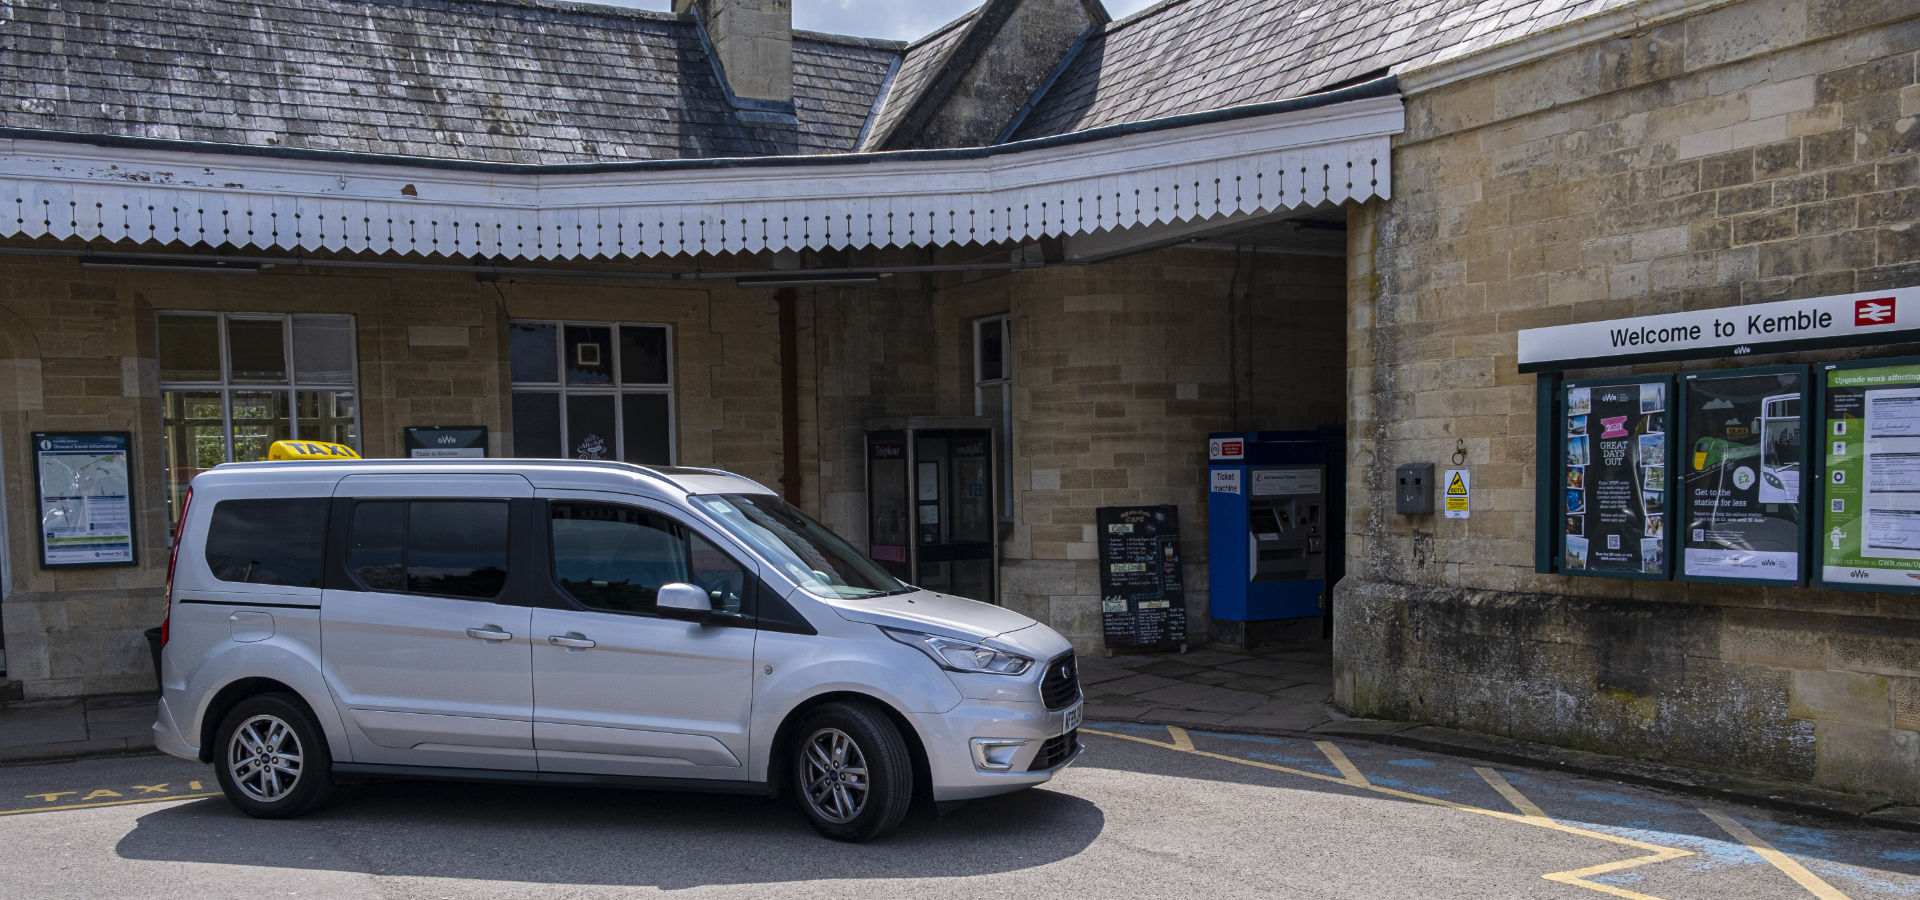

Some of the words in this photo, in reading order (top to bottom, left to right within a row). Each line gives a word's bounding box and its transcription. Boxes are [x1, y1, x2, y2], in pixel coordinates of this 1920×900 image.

[1611, 325, 1701, 348] Welcome
[1714, 318, 1735, 338] to
[1748, 309, 1832, 335] Kemble
[1734, 346, 1751, 355] GWR
[1835, 376, 1865, 385] Upgrade
[1602, 393, 1617, 403] GWR
[437, 435, 456, 444] GWR
[285, 442, 356, 457] TAXI
[1600, 441, 1628, 450] GREAT
[1603, 450, 1625, 458] DAYS
[1604, 457, 1623, 466] OUT
[1217, 473, 1235, 481] Ticket
[1738, 474, 1750, 484] £2
[1213, 484, 1238, 492] machine
[1694, 488, 1708, 496] Get
[1709, 488, 1717, 496] to
[1694, 499, 1718, 507] station
[1720, 499, 1731, 507] for
[1732, 499, 1748, 507] less
[1850, 569, 1869, 579] GWR
[25, 780, 203, 802] TAXI
